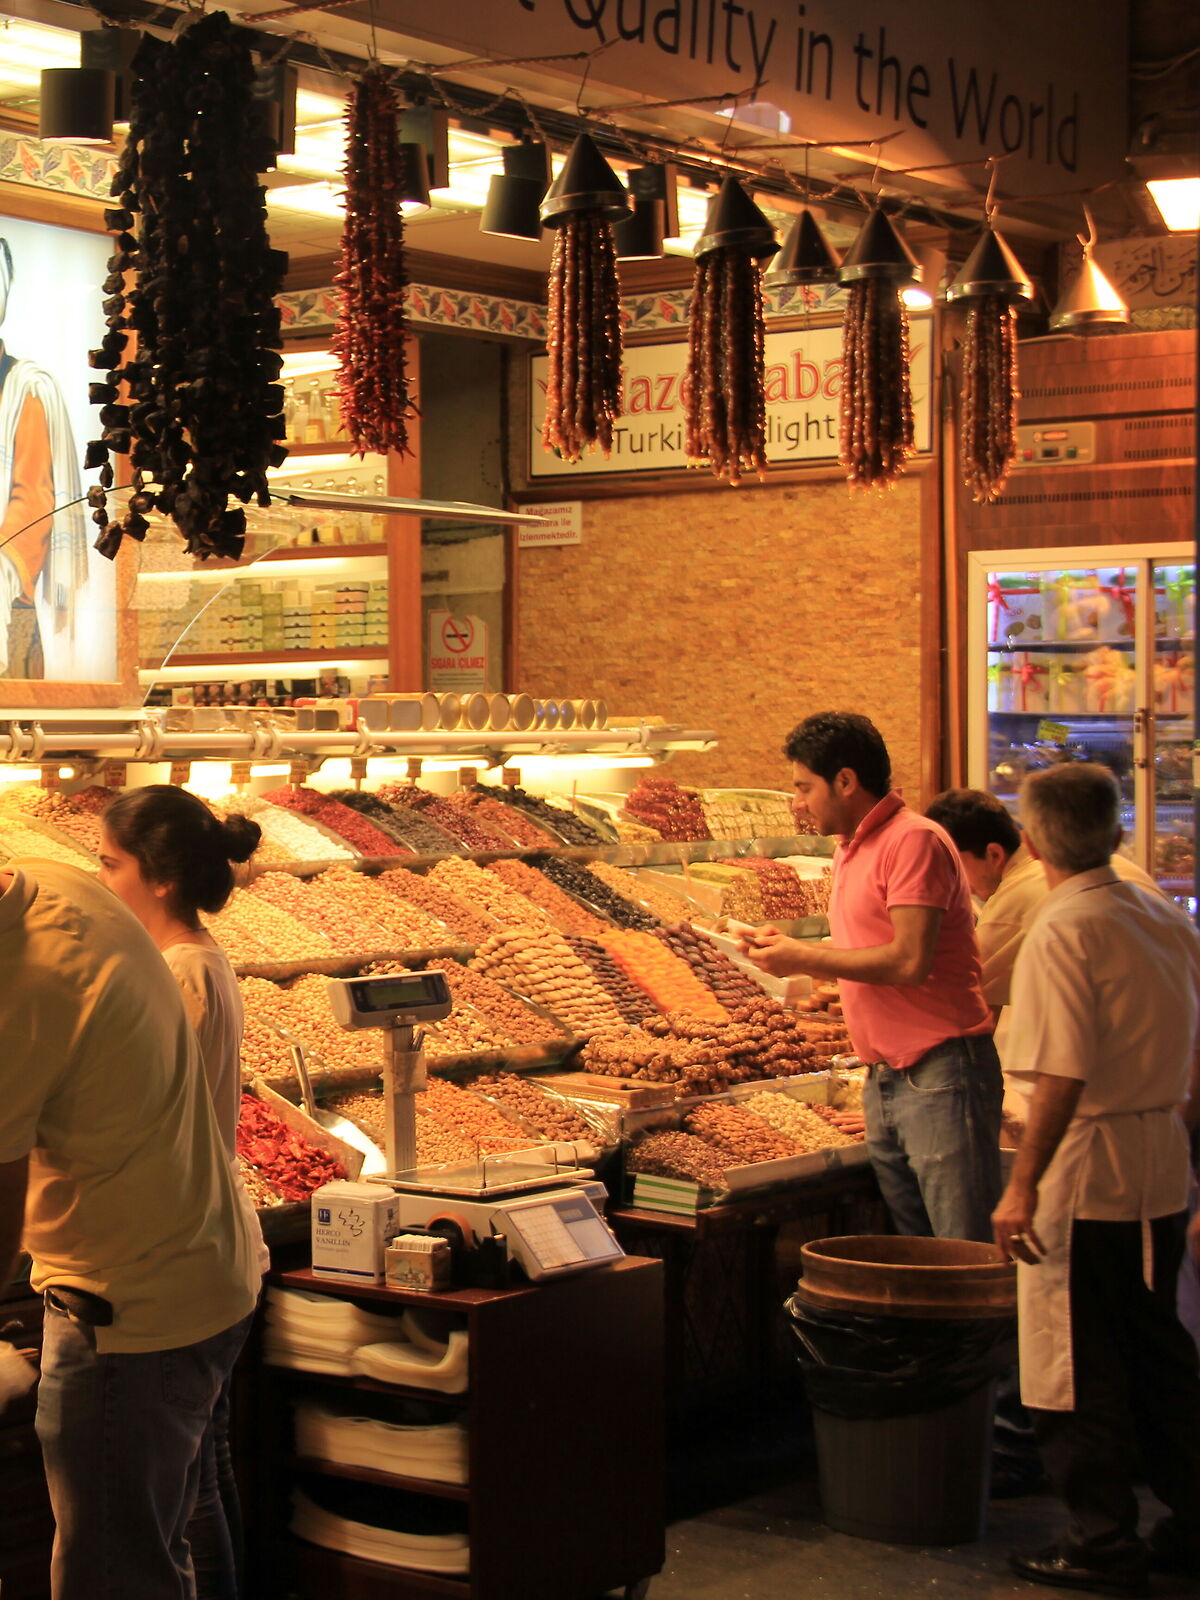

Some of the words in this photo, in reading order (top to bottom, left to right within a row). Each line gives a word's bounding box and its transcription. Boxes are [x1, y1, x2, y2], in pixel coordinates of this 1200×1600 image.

[794, 26, 833, 101] in
[852, 26, 931, 129] the
[947, 56, 1079, 173] World
[316, 1227, 341, 1237] HERCO
[316, 1236, 351, 1247] VANILLIN
